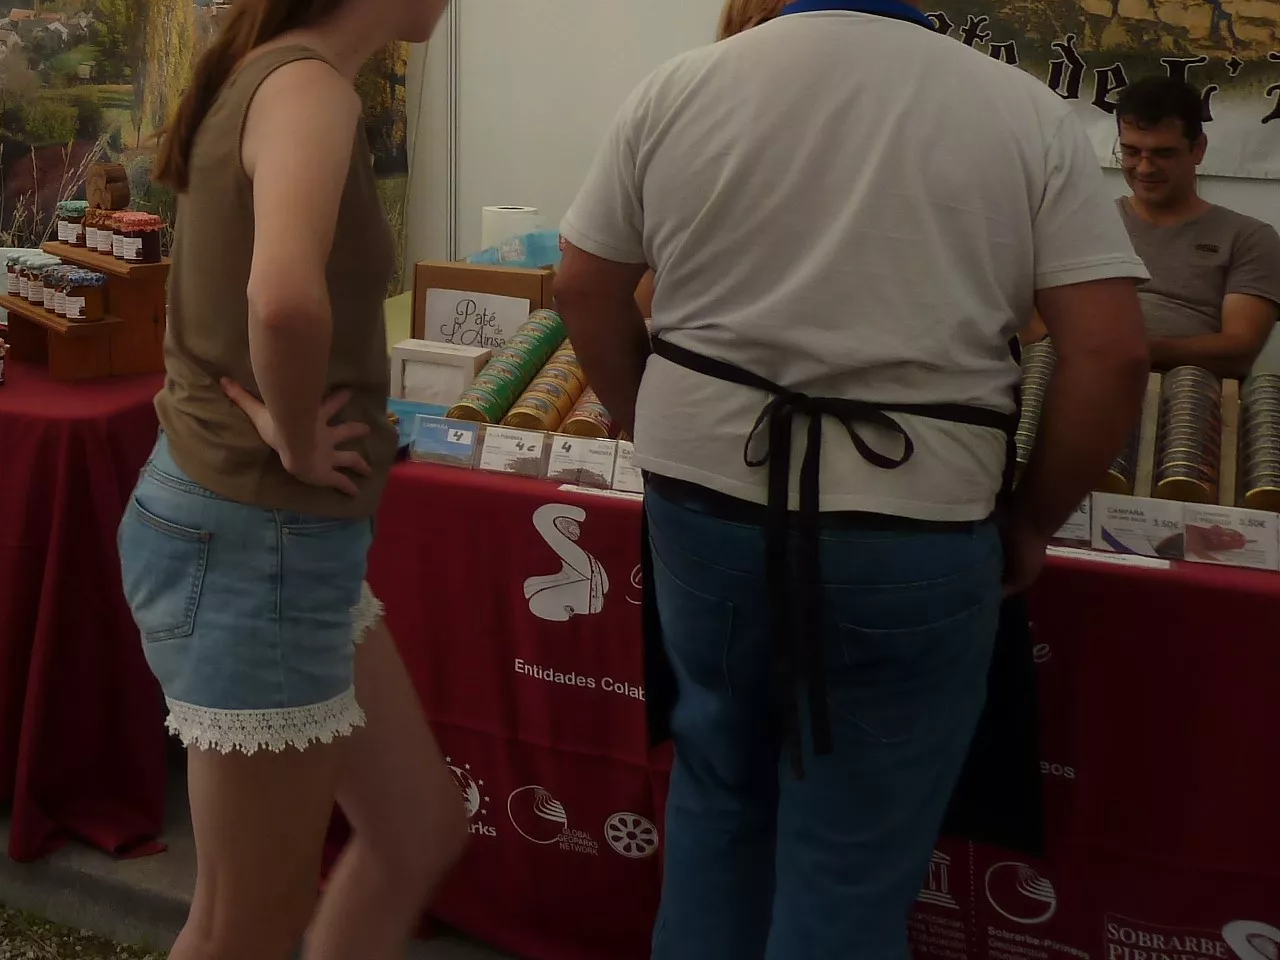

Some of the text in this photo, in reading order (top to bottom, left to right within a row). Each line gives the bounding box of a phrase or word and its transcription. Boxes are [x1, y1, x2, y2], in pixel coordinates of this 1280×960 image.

[455, 299, 496, 327] Paté
[514, 658, 596, 689] Entidades
[557, 834, 599, 849] GEOPARKS
[562, 827, 592, 840] GLOBAL
[559, 842, 599, 856] NETWORK
[1107, 923, 1227, 959] SOBRARBE
